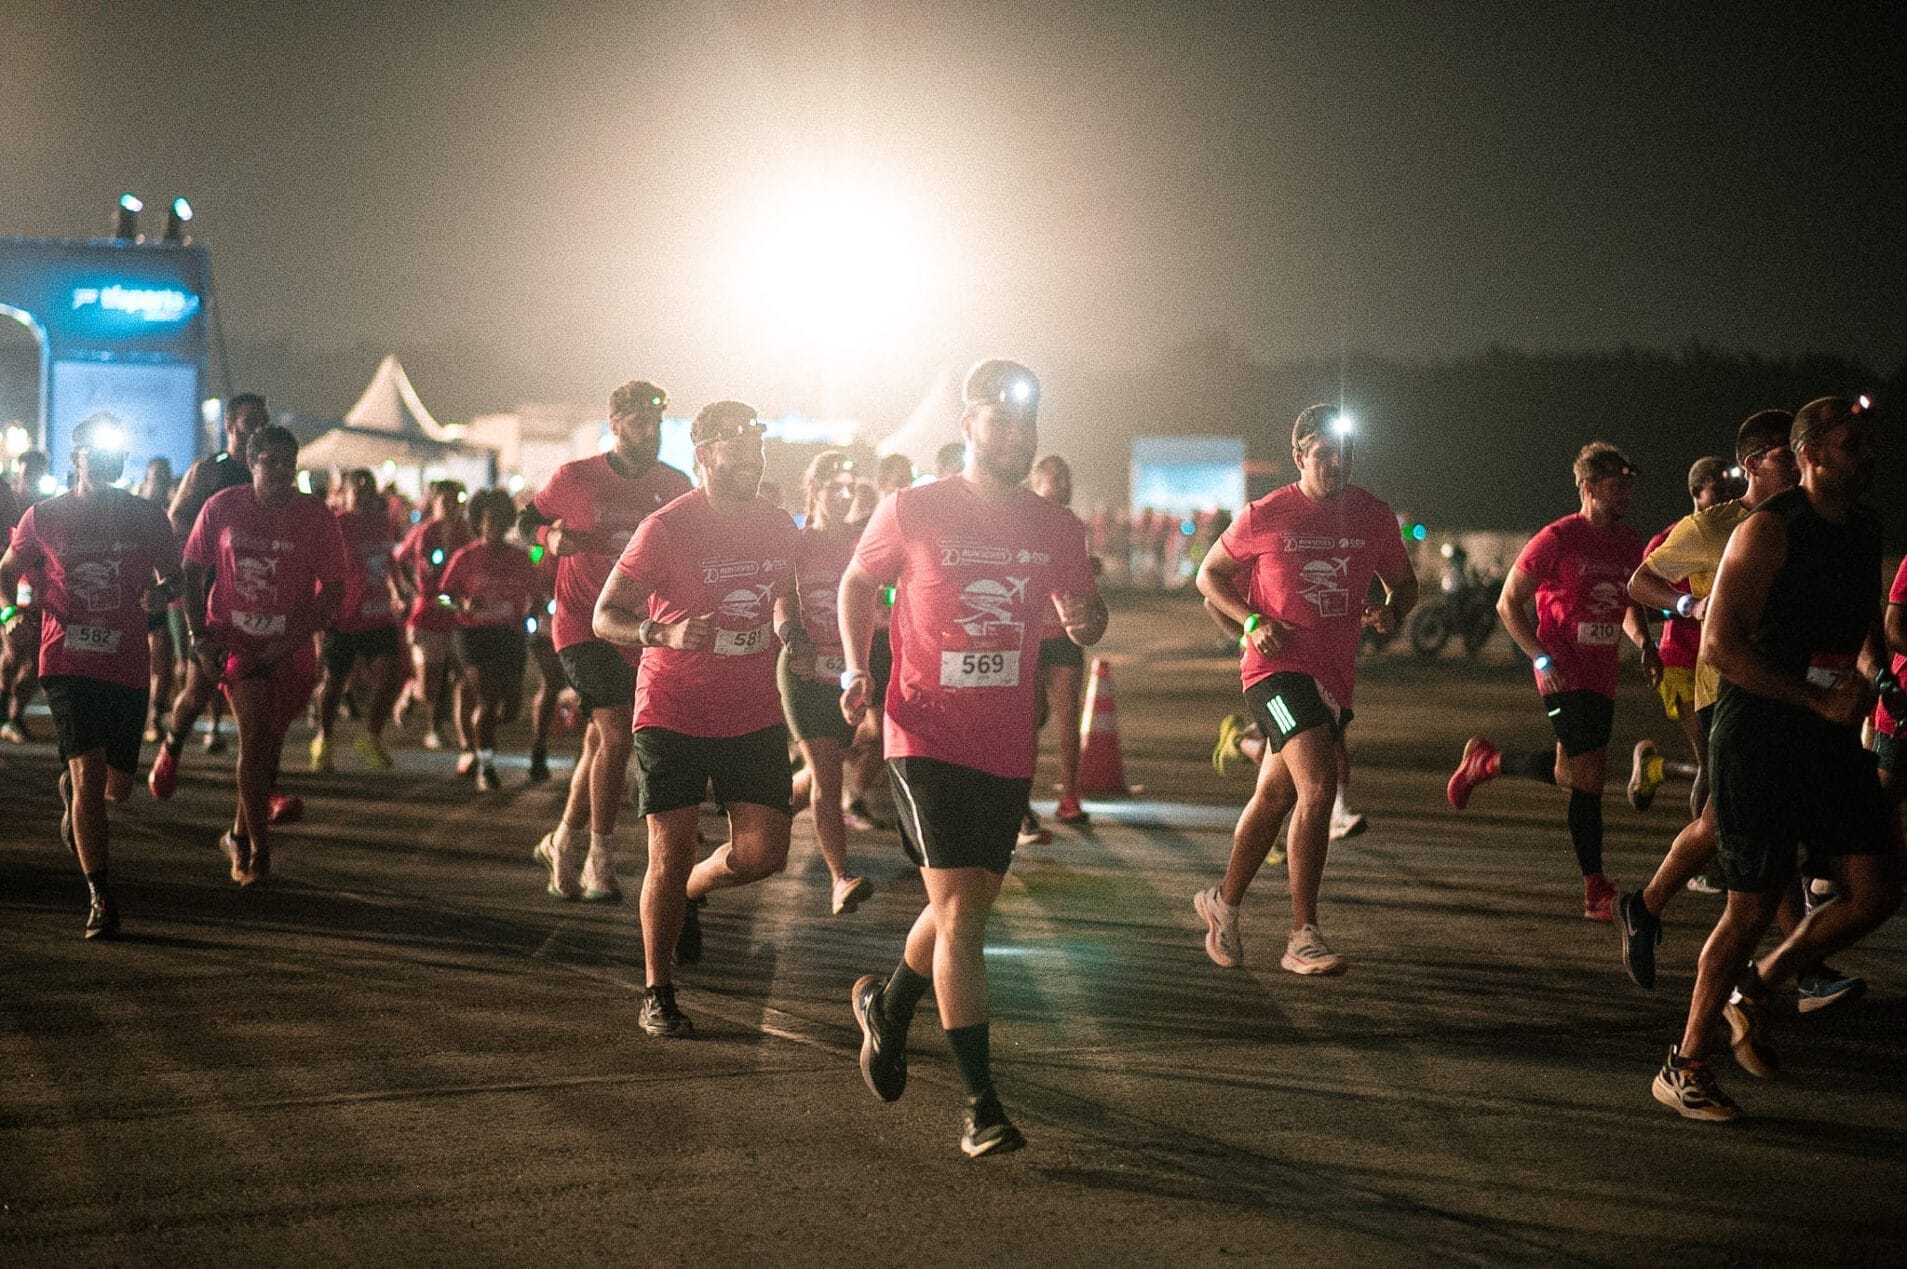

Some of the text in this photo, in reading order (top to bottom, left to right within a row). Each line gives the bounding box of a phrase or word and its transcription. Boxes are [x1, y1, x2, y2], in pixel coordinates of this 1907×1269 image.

[80, 628, 112, 643] 582
[1591, 624, 1614, 637] 210
[962, 653, 1004, 674] 569
